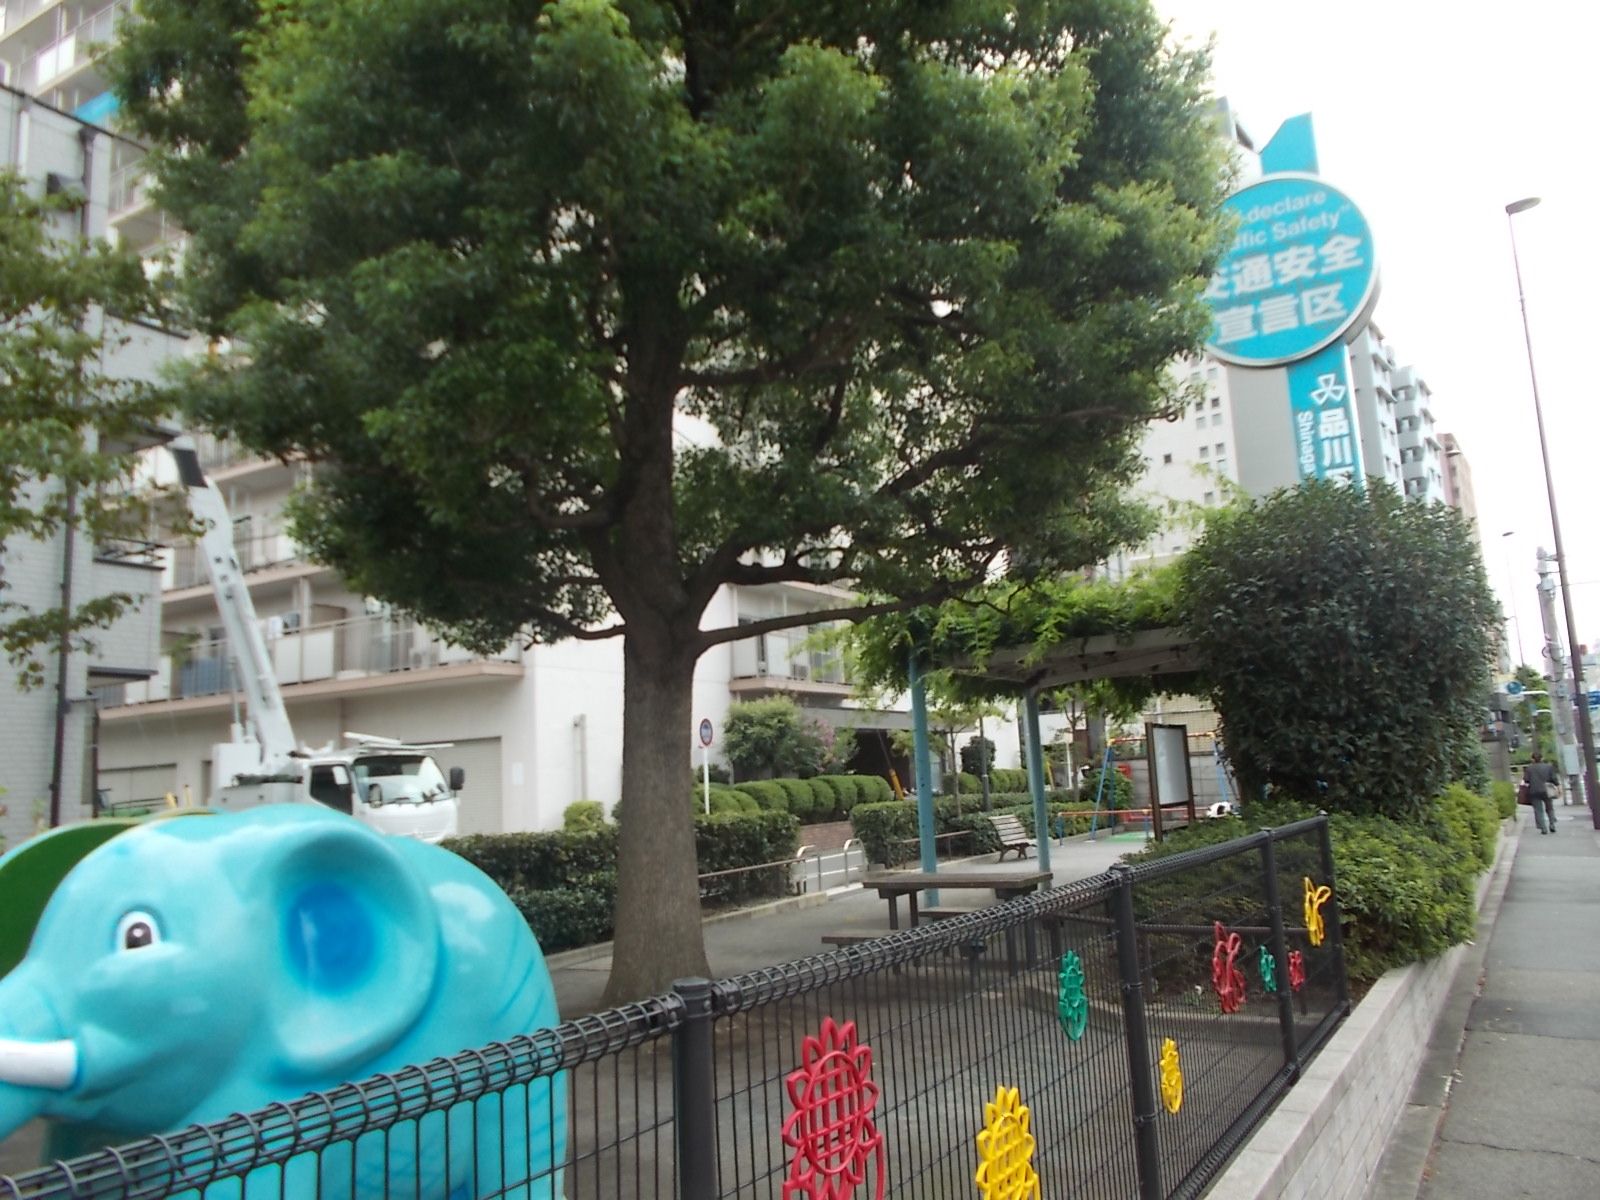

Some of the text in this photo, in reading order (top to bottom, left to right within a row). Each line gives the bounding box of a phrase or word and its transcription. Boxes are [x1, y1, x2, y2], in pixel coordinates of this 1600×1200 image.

[1247, 191, 1327, 222] declare
[1214, 282, 1348, 345] 宣言区
[1297, 410, 1317, 474] Shinaga
